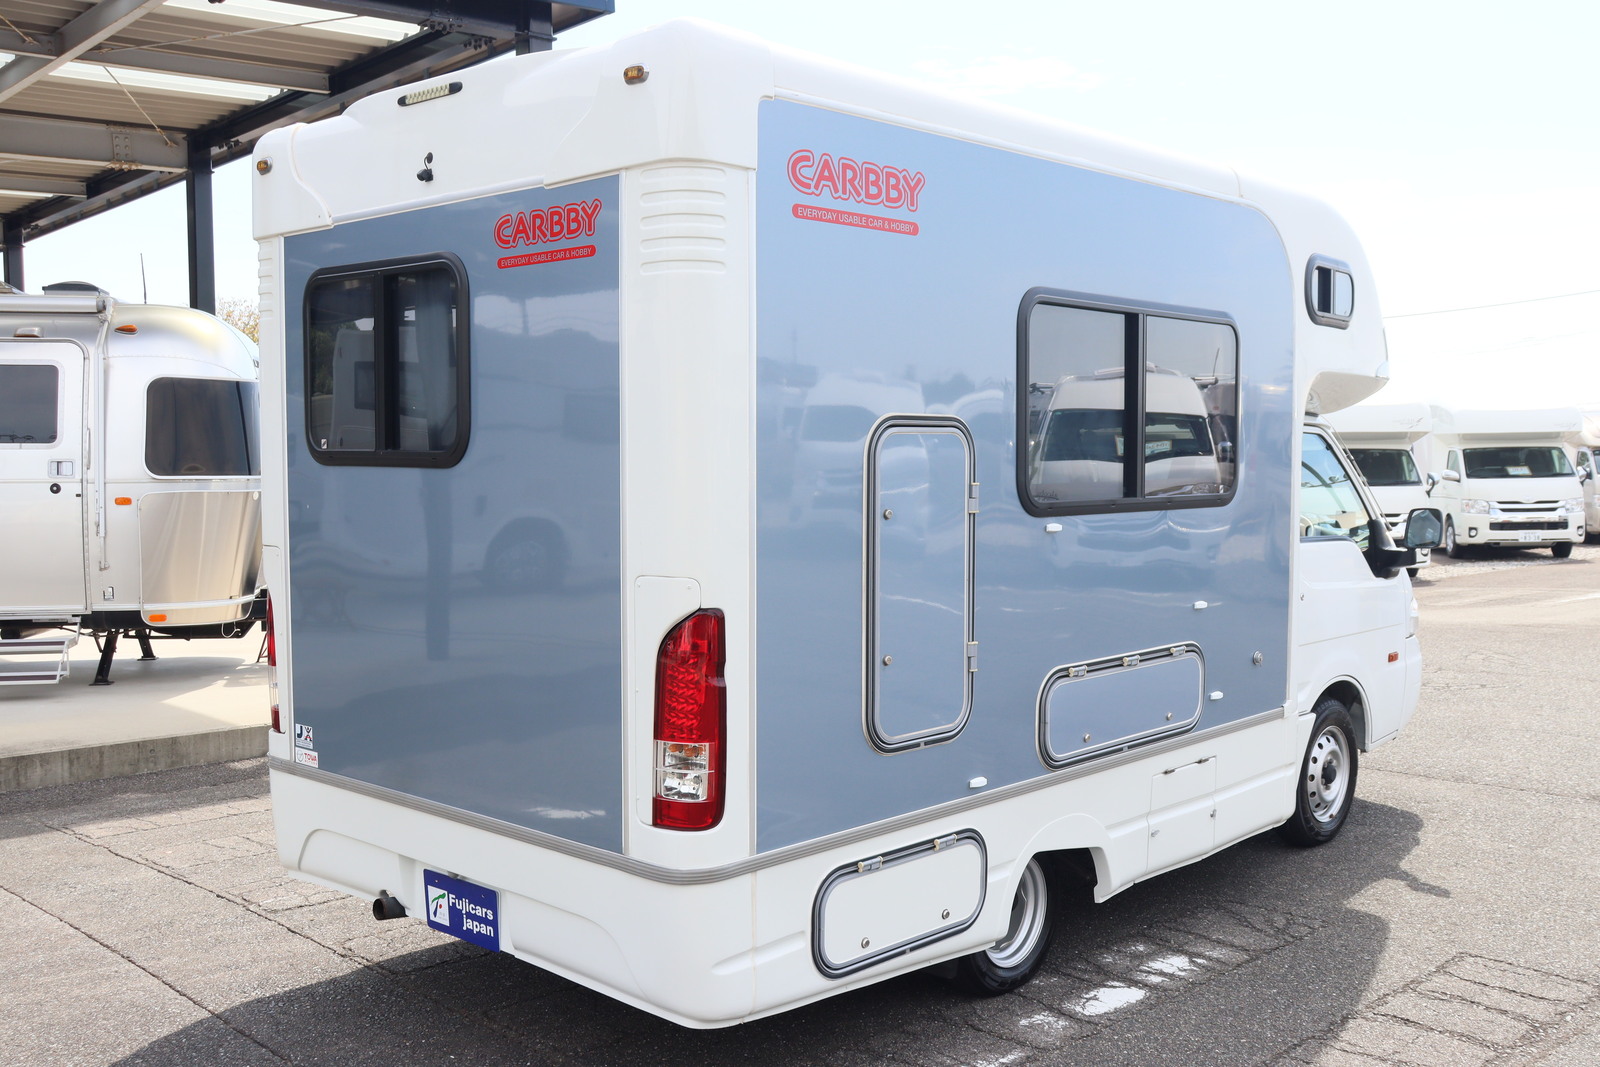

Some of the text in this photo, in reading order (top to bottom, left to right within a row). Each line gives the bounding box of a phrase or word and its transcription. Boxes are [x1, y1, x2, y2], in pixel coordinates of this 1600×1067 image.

[787, 149, 925, 212] CARBBY
[494, 199, 602, 249] CARBBY
[798, 207, 914, 232] EVERYDAY USABLE CAR & HOBBY
[501, 257, 529, 267] EVERYDAY
[530, 253, 552, 263] USABLE
[552, 251, 564, 260] CAR
[571, 247, 592, 256] HOBBY
[448, 893, 494, 920] Fujicars
[462, 914, 494, 937] japan
